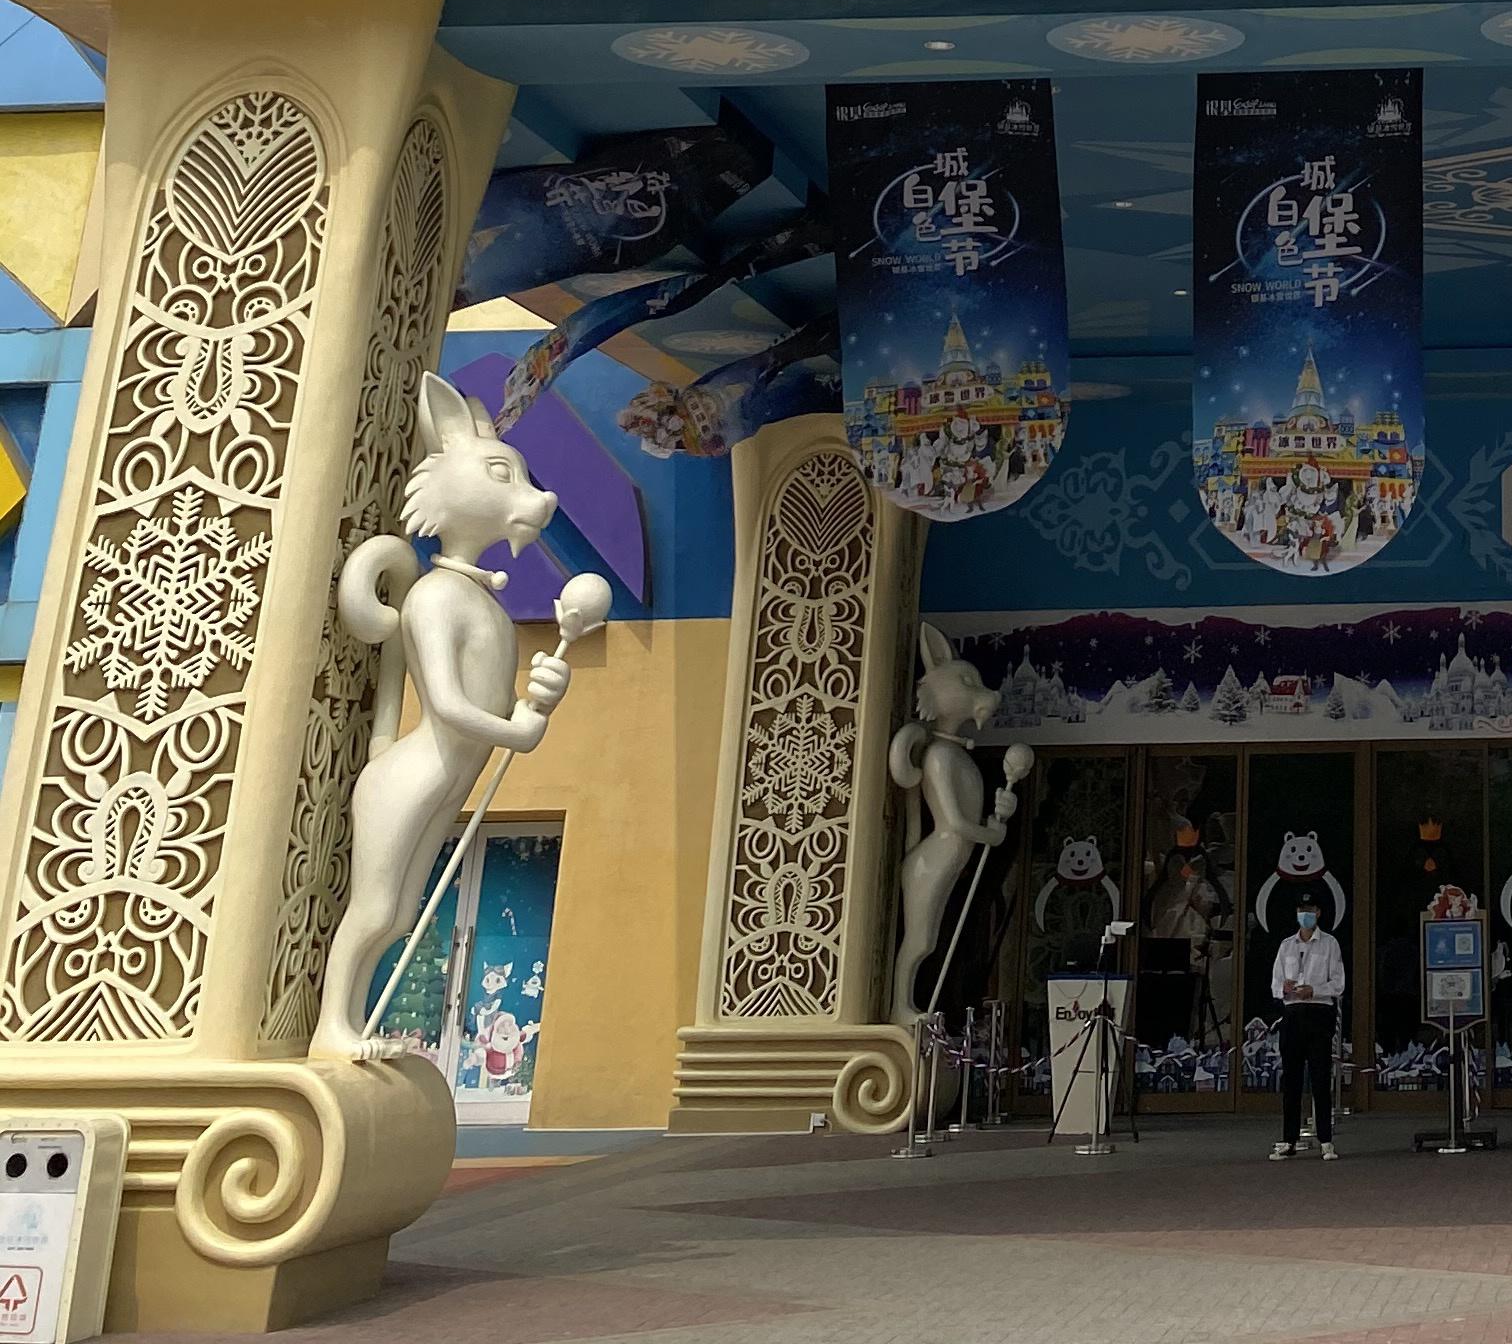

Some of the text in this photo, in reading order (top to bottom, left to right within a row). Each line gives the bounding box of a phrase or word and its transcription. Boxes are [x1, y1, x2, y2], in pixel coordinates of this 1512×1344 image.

[903, 172, 942, 243] 白色
[933, 146, 1000, 277] 城堡节
[1266, 184, 1304, 267] 白色
[1300, 154, 1364, 309] 城堡节
[871, 255, 902, 268] SNOW
[1230, 278, 1302, 295] SNOW WORLD
[1278, 435, 1338, 450] 冰雪世界
